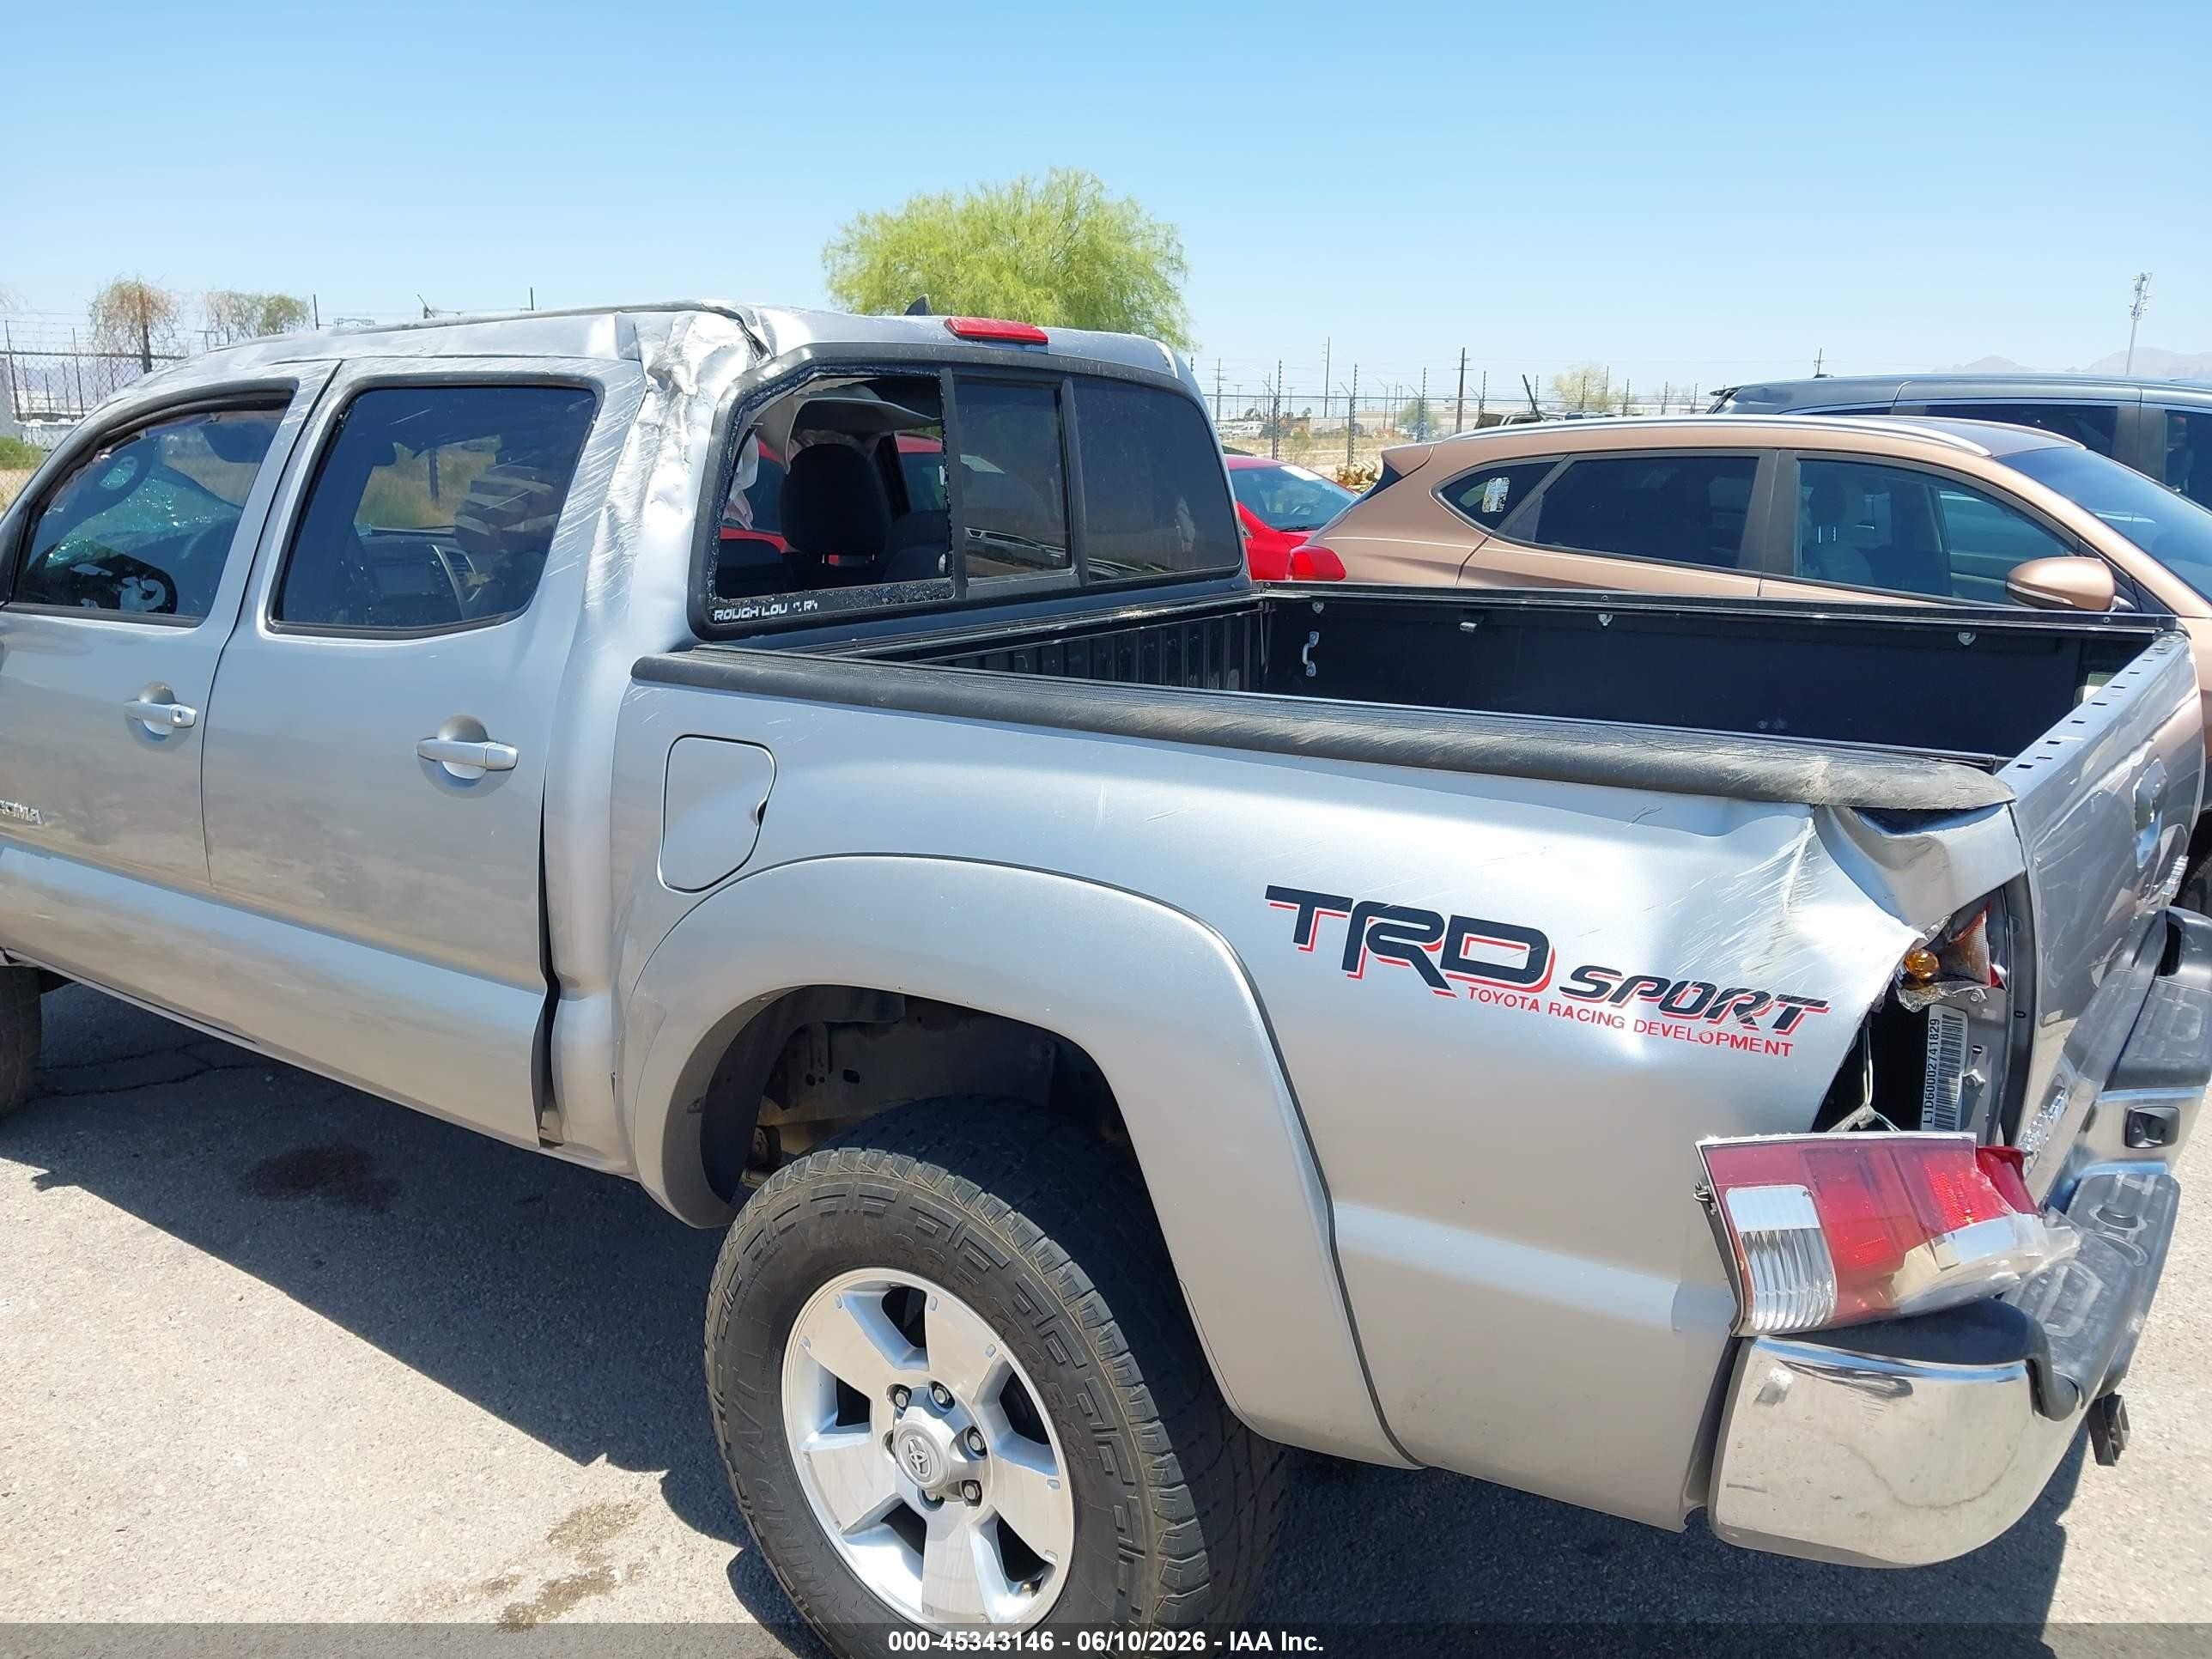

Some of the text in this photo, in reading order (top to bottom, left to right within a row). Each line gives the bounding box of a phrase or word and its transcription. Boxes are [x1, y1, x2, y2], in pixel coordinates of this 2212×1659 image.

[714, 606, 759, 621] ROUGH
[1265, 884, 1829, 1037] TRD SPORT
[1468, 986, 1795, 1057] TOYOTA RACING DEVELOPMENT
[1923, 1018, 1940, 1125] L1D60002741829
